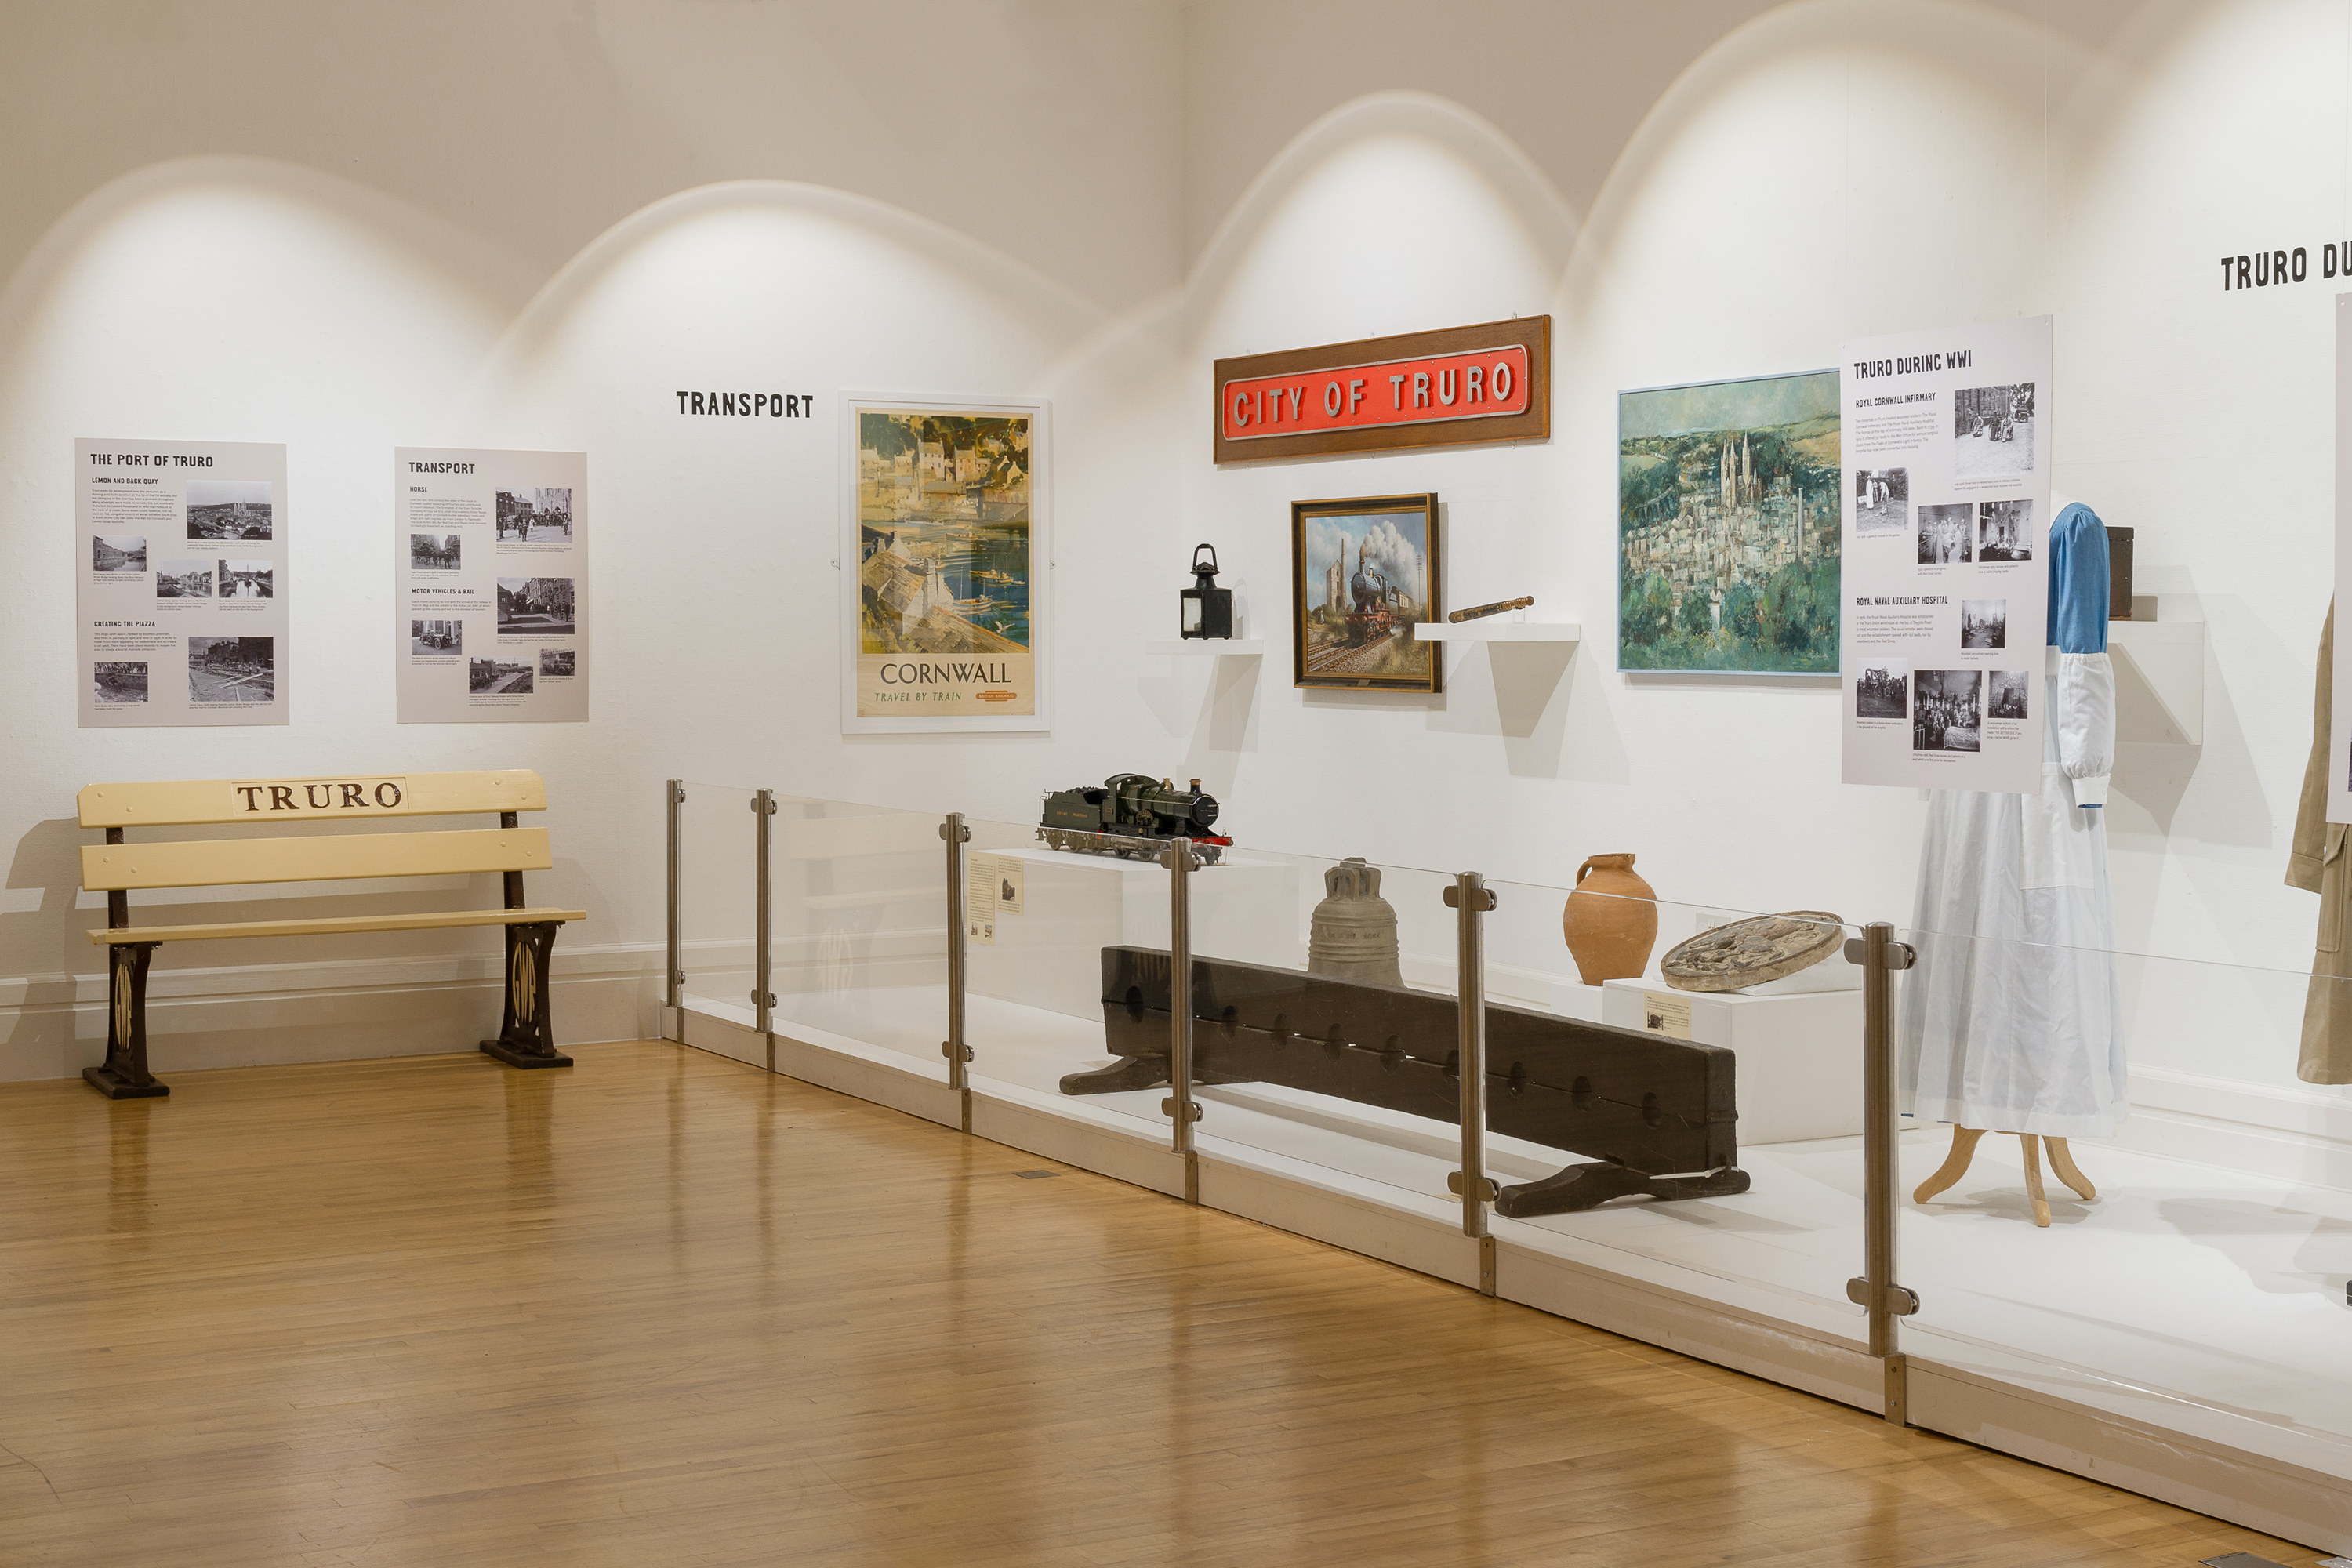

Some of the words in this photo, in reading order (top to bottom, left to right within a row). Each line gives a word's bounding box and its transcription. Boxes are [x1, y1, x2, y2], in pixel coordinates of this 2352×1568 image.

[2221, 247, 2307, 291] TRURO
[1854, 359, 1892, 379] TRURO
[1897, 354, 1941, 374] DURING
[1947, 350, 1971, 368] WWI
[1234, 387, 1304, 426] CITY
[1324, 379, 1366, 417] OF
[1389, 361, 1513, 410] TRURO
[1856, 398, 1873, 408] ROYAL
[1874, 395, 1903, 406] CORNWALL
[1905, 392, 1935, 403] INFIRMARY
[677, 391, 813, 418] TRANSPORT
[91, 453, 113, 465] THE
[117, 454, 149, 466] PORT
[154, 455, 168, 466] OF
[173, 456, 213, 467] TRURO
[409, 462, 475, 474] TRANSPORT
[1856, 597, 1873, 606] ROYAL
[1875, 597, 1891, 605] NAVAL
[1892, 596, 1920, 605] AUXILIARY
[1922, 595, 1948, 604] HOSPITAL
[881, 663, 1011, 684] CORNWALL
[875, 692, 911, 702] TRAVEL
[916, 692, 927, 702] BY
[933, 691, 962, 702] TRAIN
[238, 783, 401, 811] TRURO
